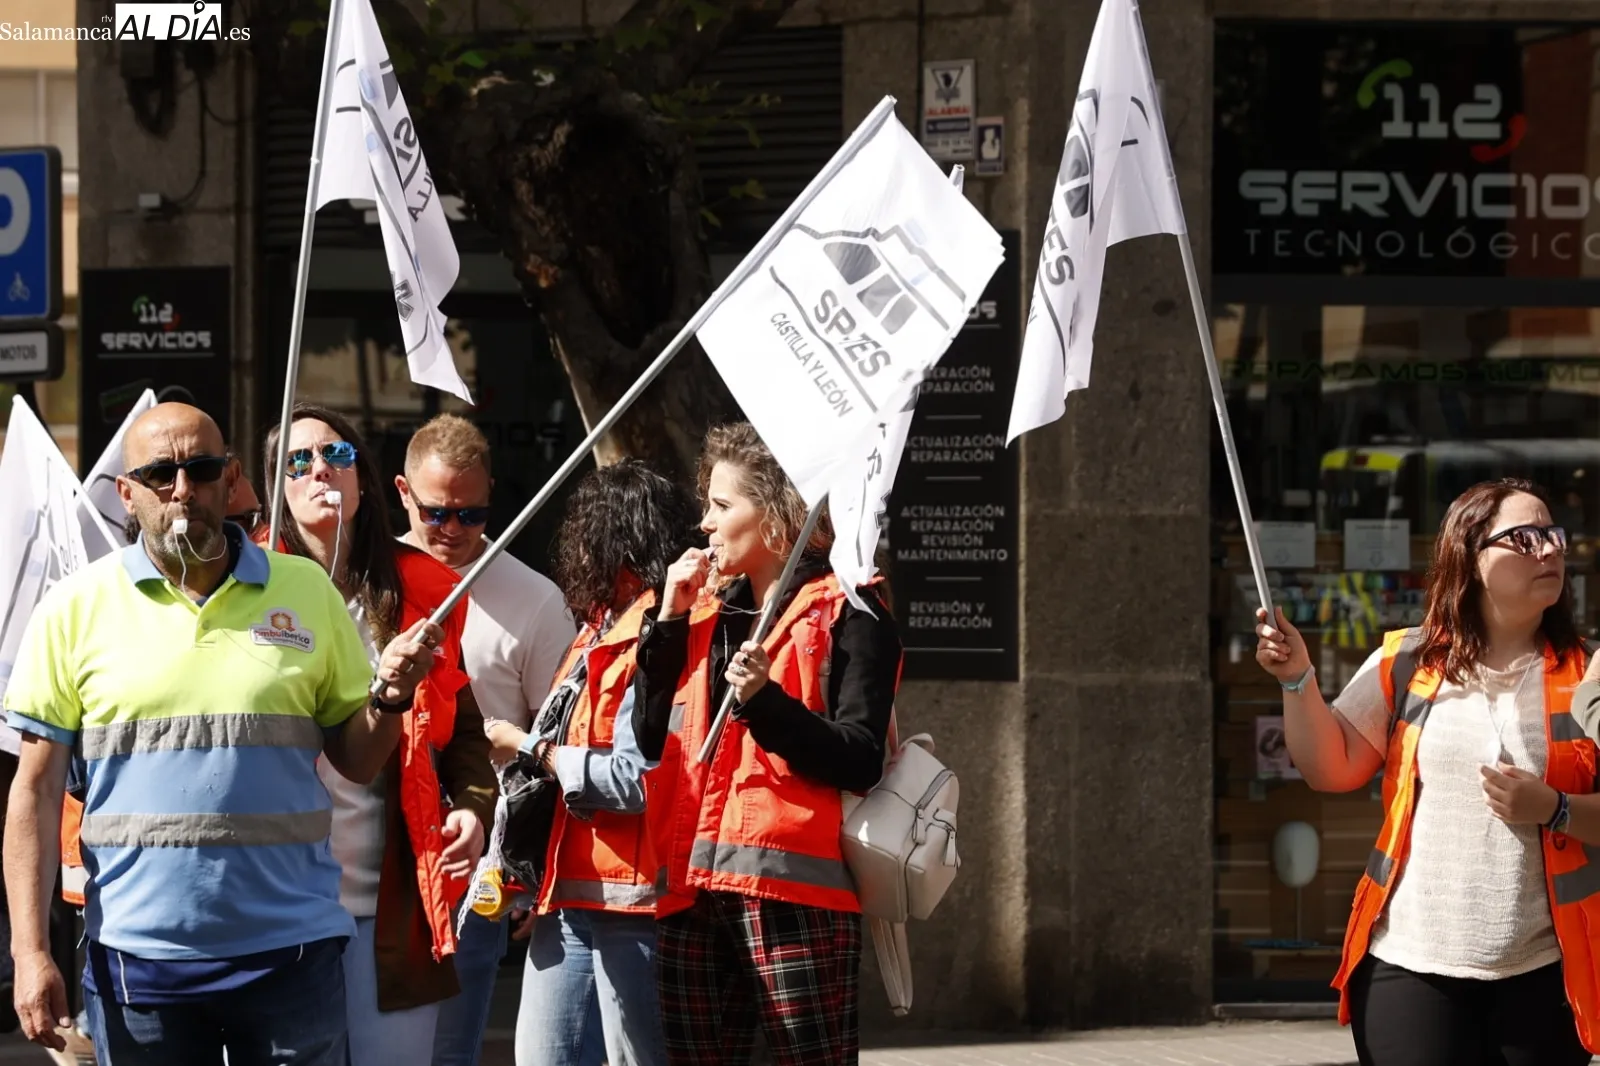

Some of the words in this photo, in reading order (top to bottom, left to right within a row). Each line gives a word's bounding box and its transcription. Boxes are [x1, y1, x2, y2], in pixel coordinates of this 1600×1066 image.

[1381, 82, 1503, 140] 112
[1238, 168, 1600, 220] SERVICIO
[138, 302, 174, 324] 112
[100, 330, 212, 351] SERVICIOS
[770, 312, 815, 367] CASTILLA
[813, 370, 854, 417] LEÓN
[920, 380, 995, 394] EPARACIÓN
[911, 449, 995, 463] REPARACIÓN
[901, 504, 1005, 519] ACTUALIZACIÓN
[911, 519, 995, 533] REPARACIÓN
[921, 533, 984, 547] REVISIÓN
[897, 548, 1008, 562] MANTENIMIENTO
[910, 601, 971, 615] REVISIÓN
[908, 616, 993, 629] REPARACIÓN
